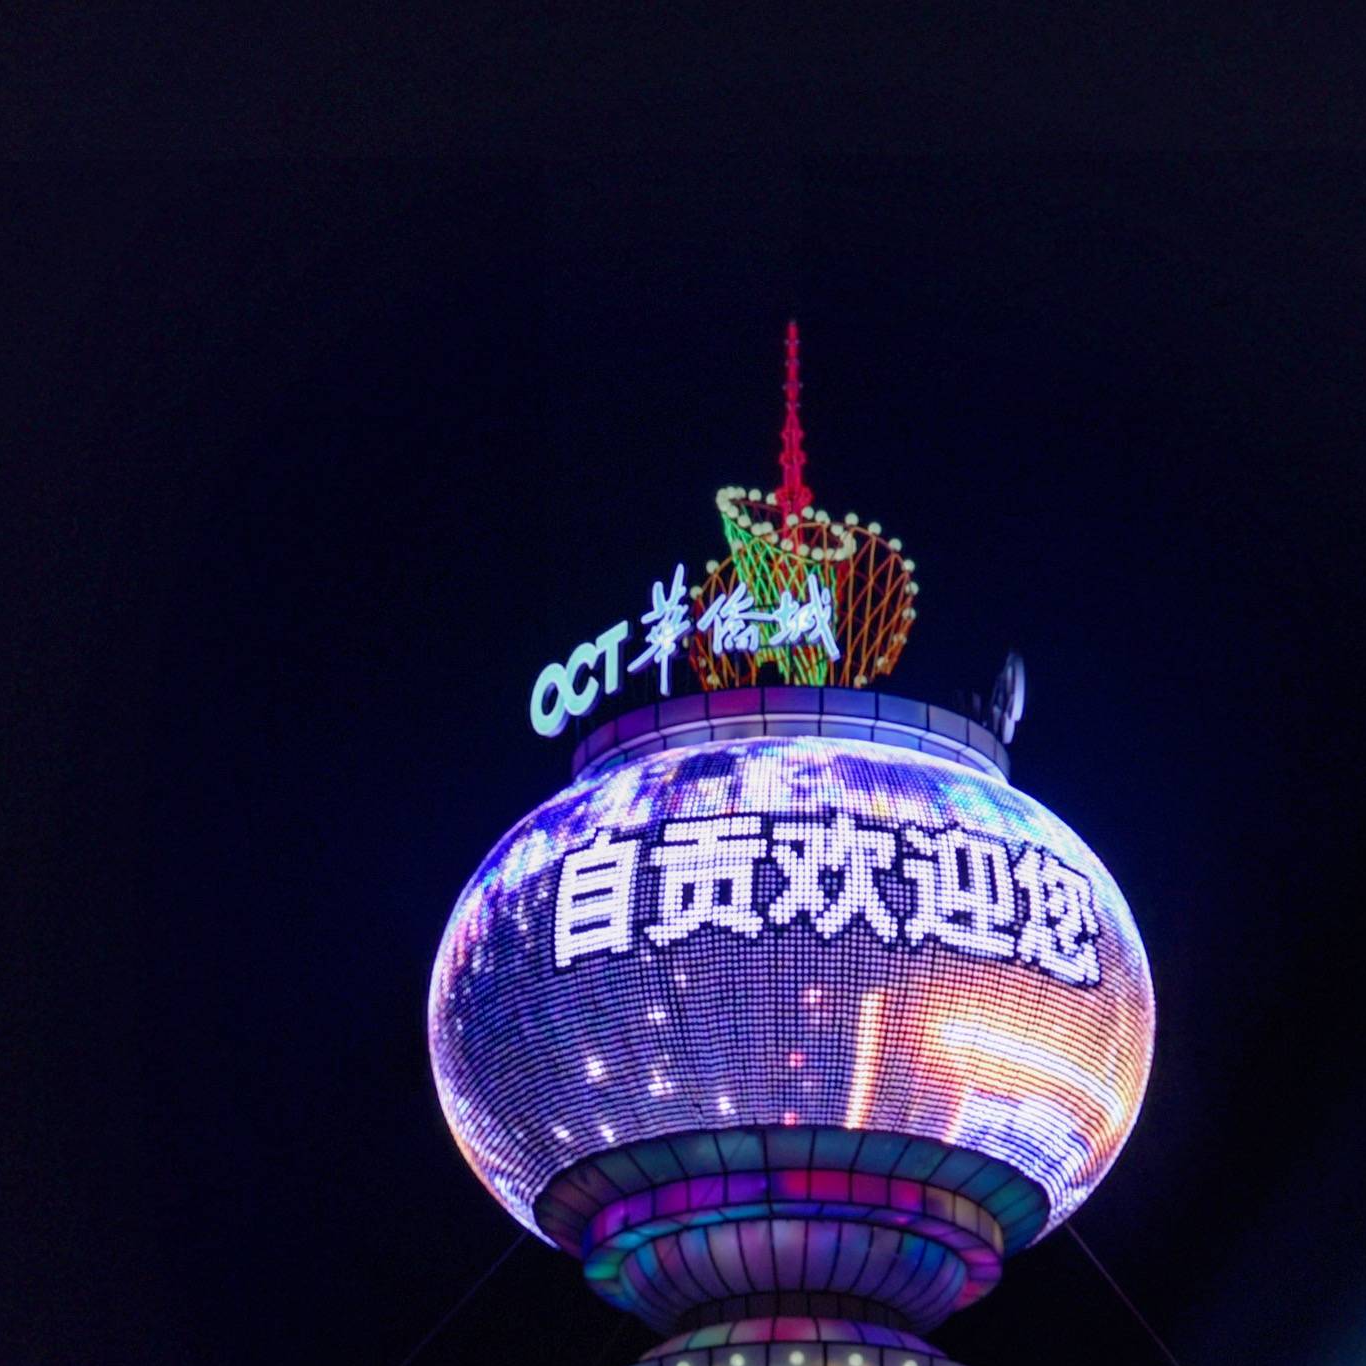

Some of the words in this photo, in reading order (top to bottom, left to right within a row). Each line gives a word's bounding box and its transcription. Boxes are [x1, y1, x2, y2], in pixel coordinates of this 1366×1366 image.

[530, 620, 629, 738] OCT
[554, 813, 1101, 985] 自贡欢迎您
